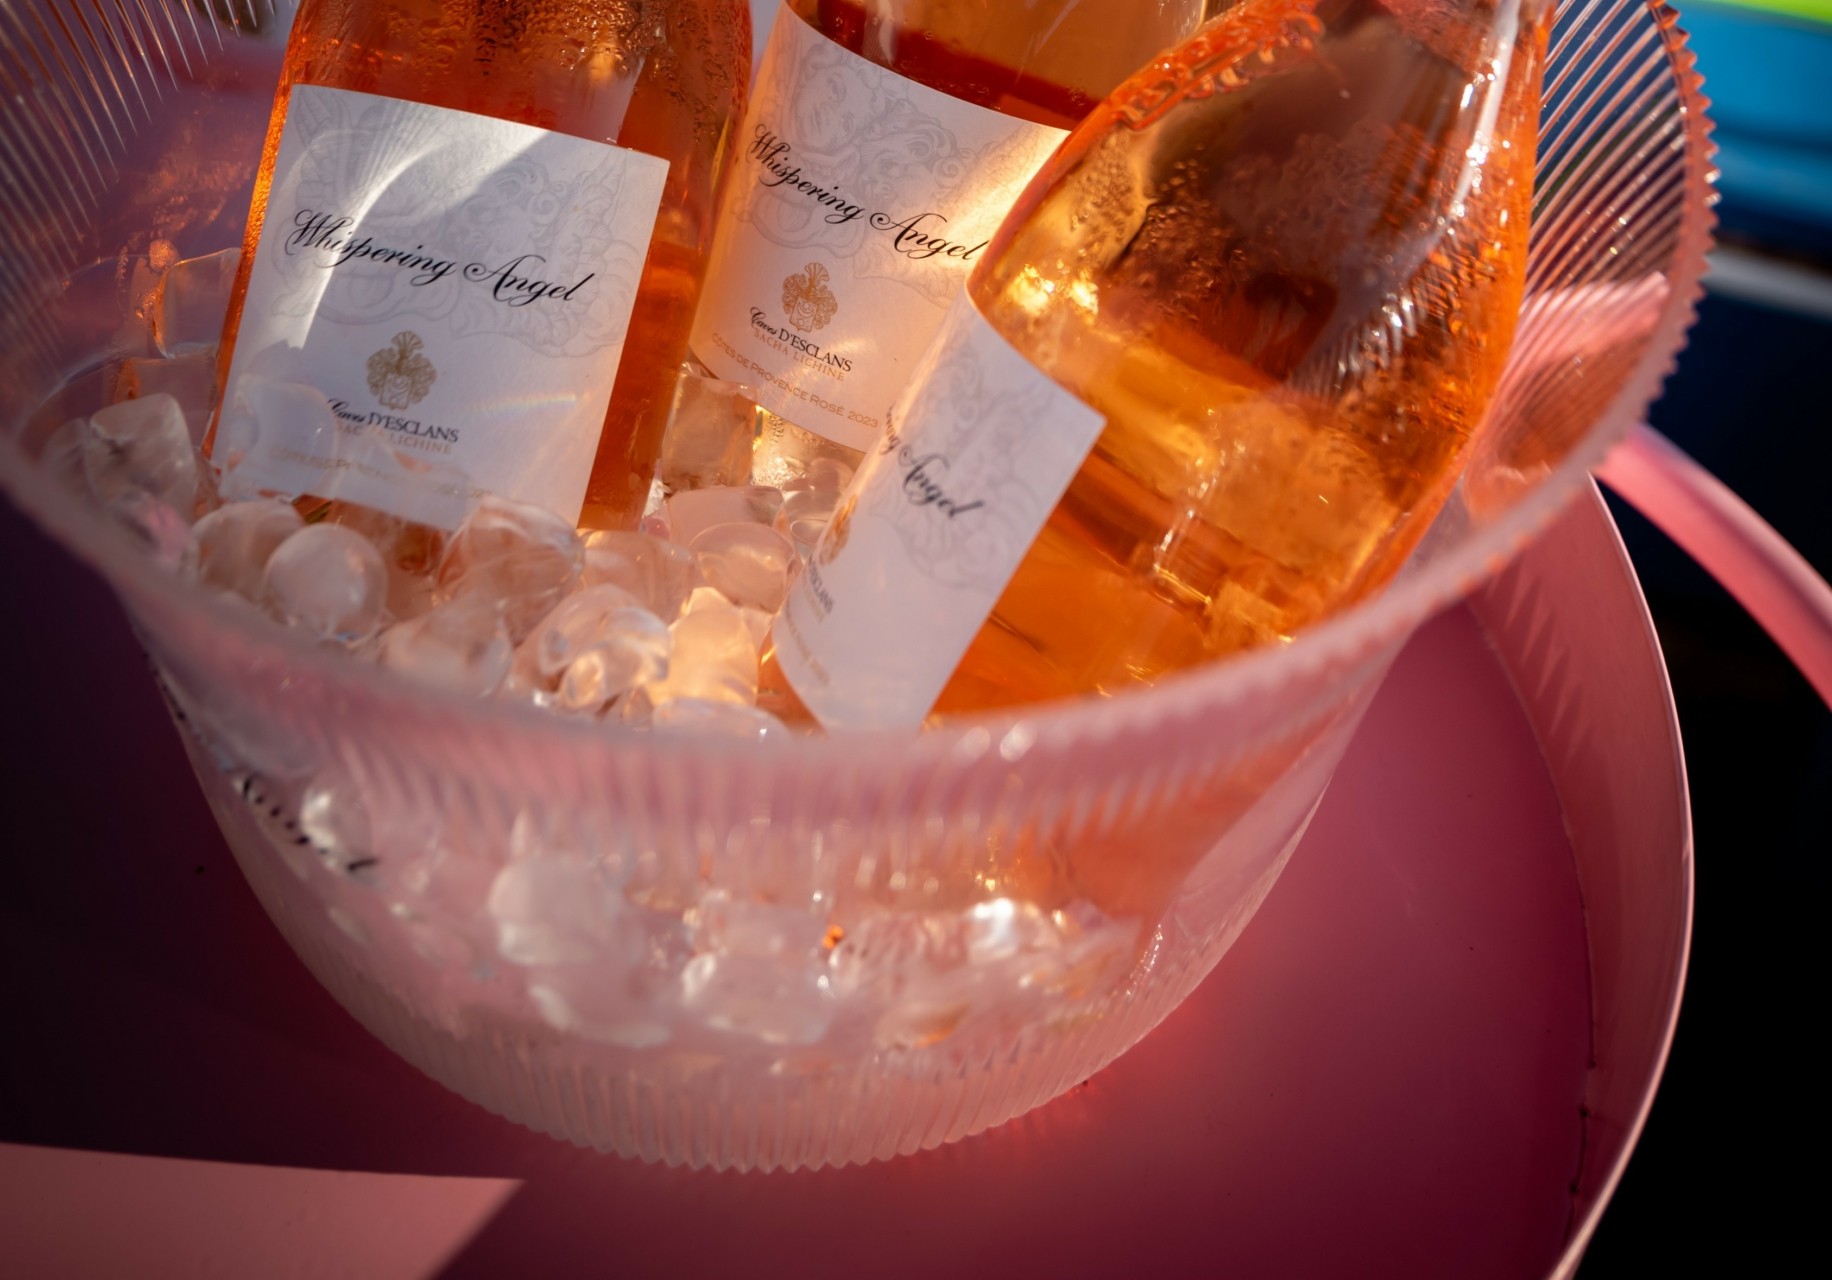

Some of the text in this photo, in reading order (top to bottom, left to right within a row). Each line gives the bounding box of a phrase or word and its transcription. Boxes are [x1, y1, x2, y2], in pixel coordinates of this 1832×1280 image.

[745, 123, 989, 261] Whispering Angel
[284, 209, 596, 308] Whispering Angel
[749, 306, 853, 372] Caves D'ESCLANS
[752, 327, 846, 382] SACHA LICHINE
[735, 353, 751, 370] DE
[847, 410, 879, 428] 2023
[367, 411, 460, 443] D'ESCLANS
[389, 434, 455, 455] LICHINE
[898, 443, 986, 519] Angel
